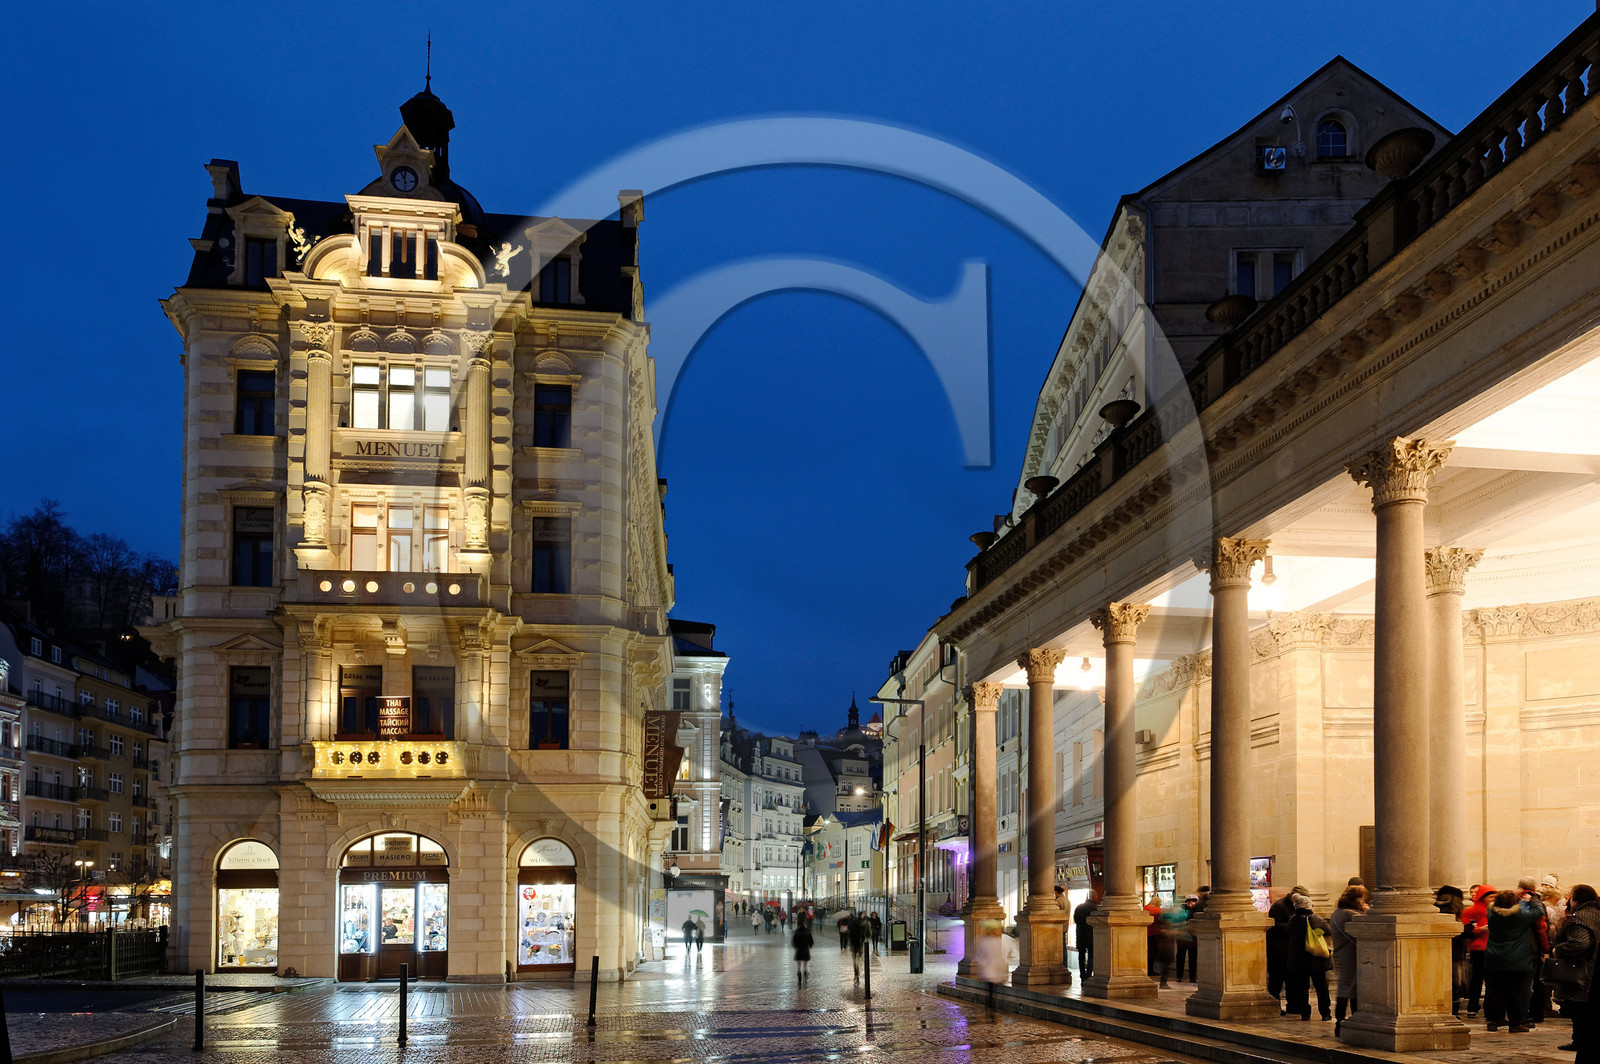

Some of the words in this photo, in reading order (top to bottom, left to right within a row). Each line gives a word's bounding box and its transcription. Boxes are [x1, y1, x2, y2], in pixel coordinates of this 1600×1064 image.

[355, 440, 445, 458] MENUET
[386, 699, 402, 707] THAI
[379, 708, 409, 716] MASSAGE
[379, 718, 409, 727] ТАЙСКИЙ
[644, 714, 661, 797] MENUET
[363, 871, 427, 881] PREMIUM
